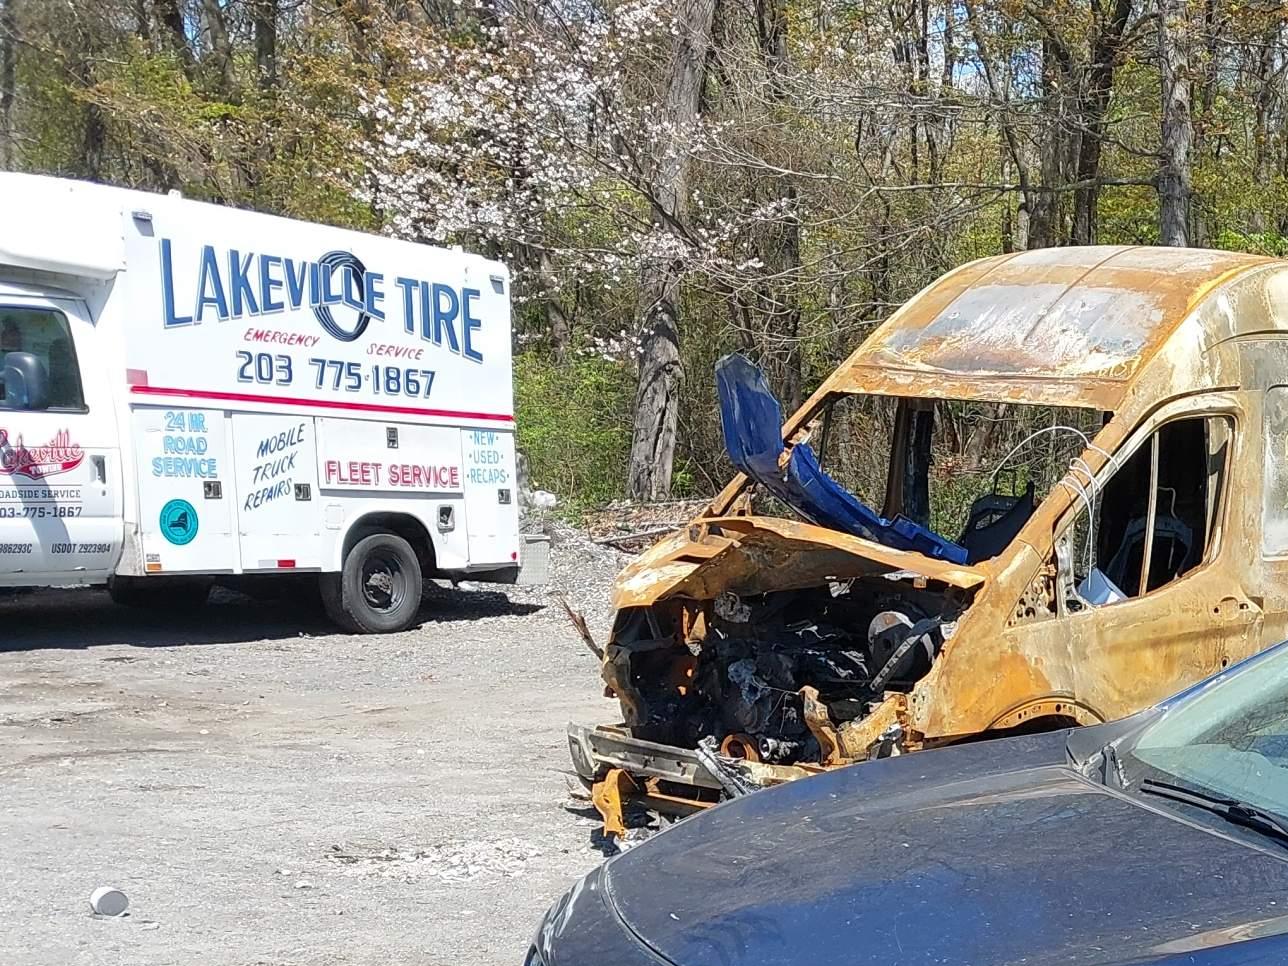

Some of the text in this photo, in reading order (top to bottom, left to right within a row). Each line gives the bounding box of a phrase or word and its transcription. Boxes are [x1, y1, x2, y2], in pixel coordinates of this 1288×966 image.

[159, 238, 484, 364] LAKEVILLE TIRE
[244, 328, 425, 361] EMERGENCY SERVICE
[236, 350, 293, 386] 203
[163, 411, 185, 432] 24
[162, 435, 208, 455] ROAD
[256, 423, 306, 459] MOBILE
[473, 430, 495, 446] NEW
[151, 457, 218, 479] SERVICE
[252, 450, 298, 485] TRUCK
[473, 451, 500, 464] USED
[325, 460, 460, 488] FLEET SERVICE
[470, 468, 507, 484] RECAPS
[41, 489, 81, 498] SERVICE
[243, 478, 292, 512] REPAIRS
